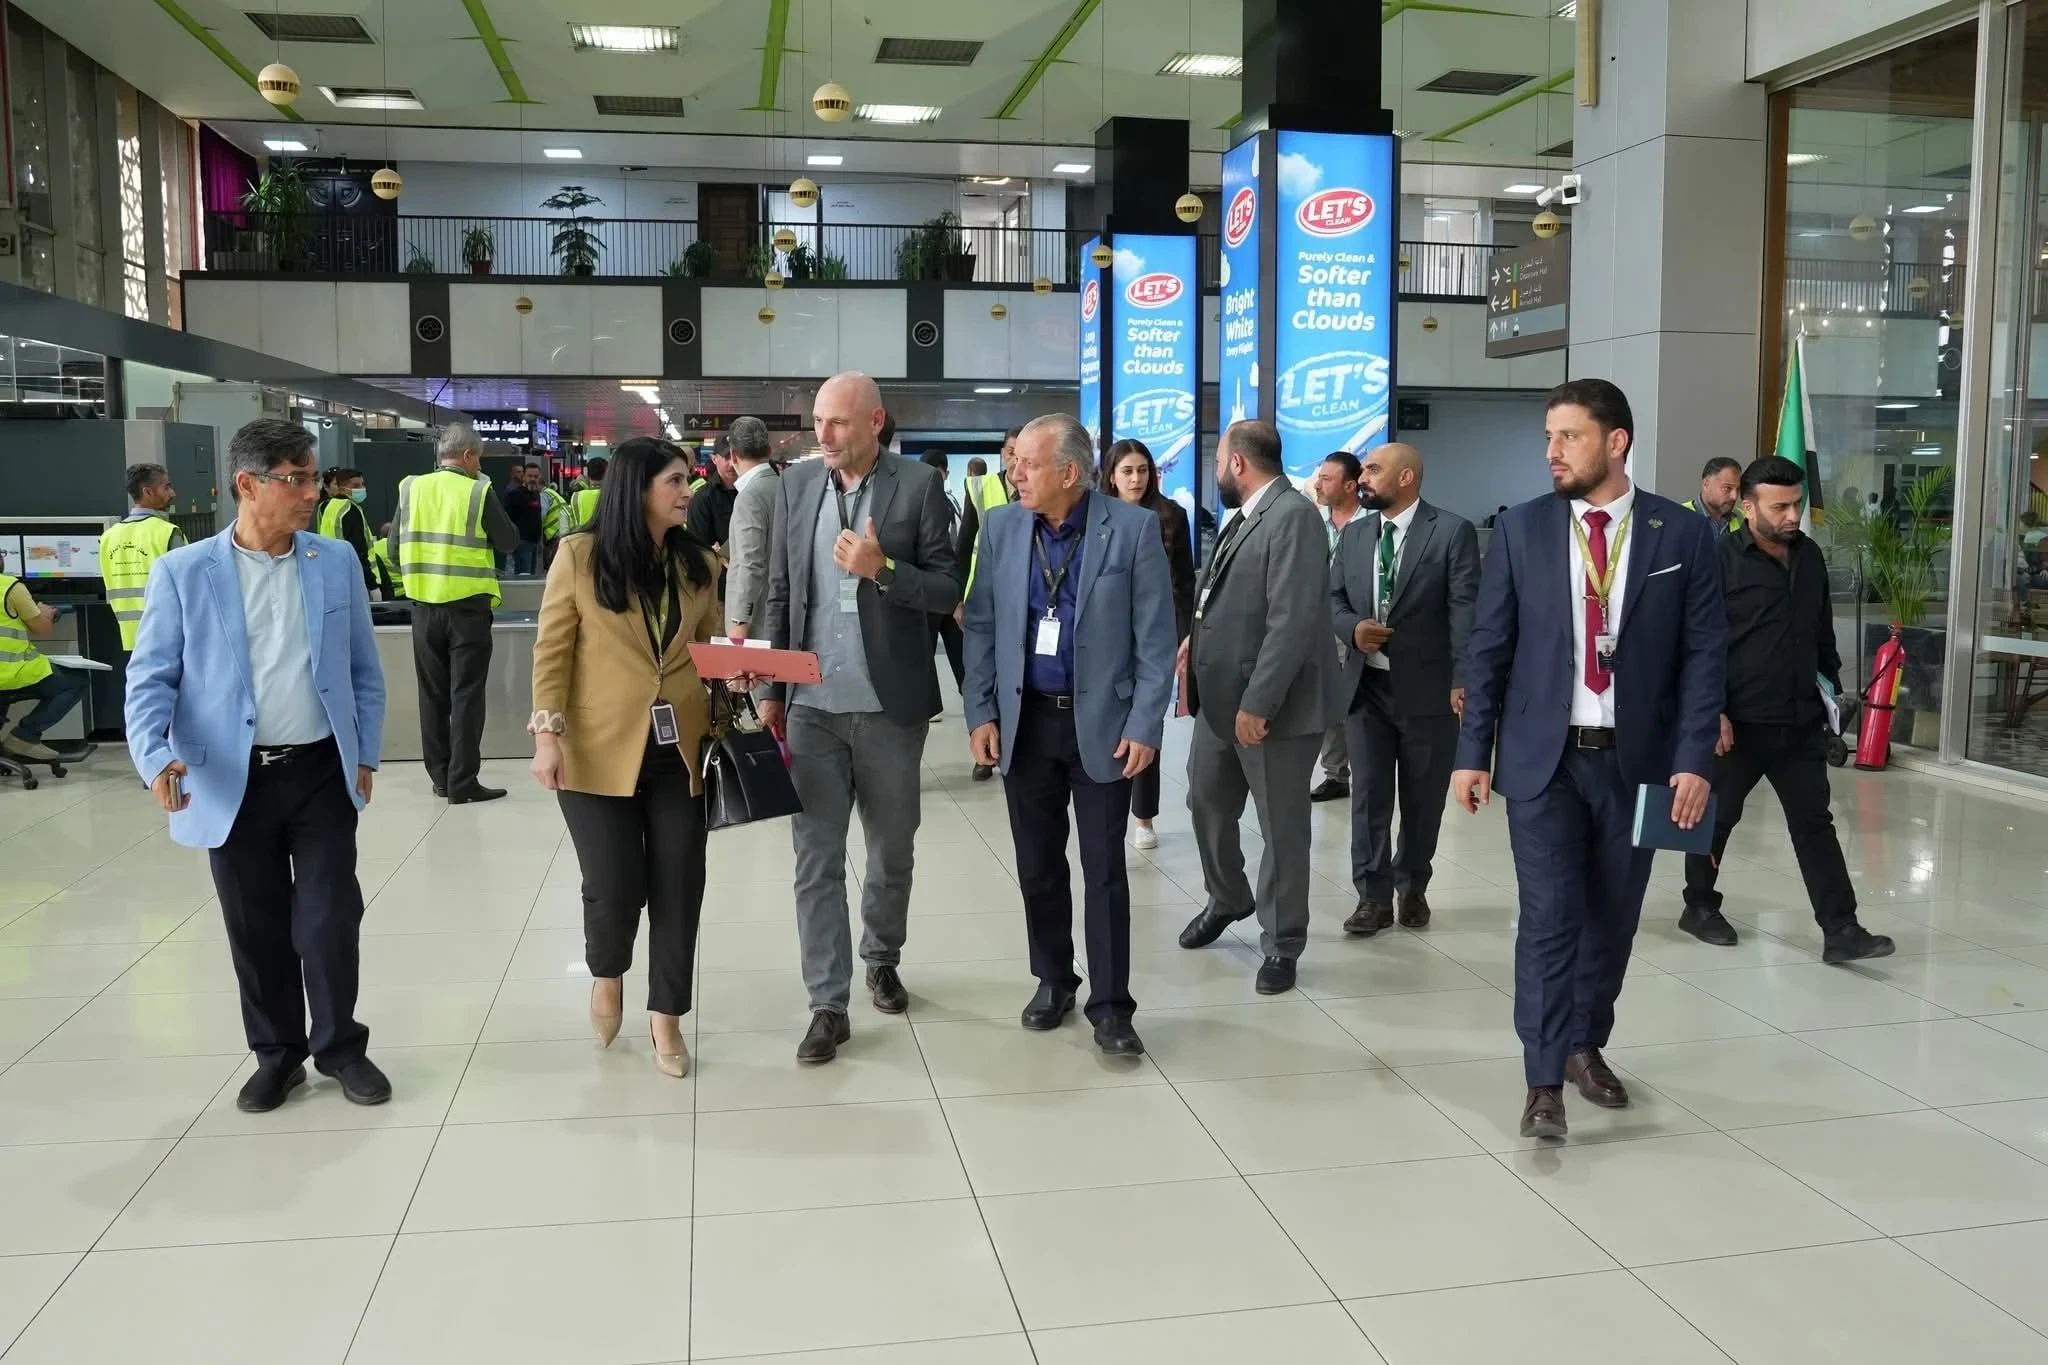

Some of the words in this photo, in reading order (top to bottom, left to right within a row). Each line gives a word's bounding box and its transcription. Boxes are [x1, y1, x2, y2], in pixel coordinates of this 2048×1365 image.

[1229, 193, 1253, 233] LET'S
[1307, 196, 1368, 222] LET'S
[1325, 217, 1352, 226] CLEAN
[1298, 251, 1333, 264] Purely
[1335, 252, 1366, 263] Clean
[1367, 253, 1376, 264] &
[1297, 265, 1372, 286] Softer
[1134, 278, 1178, 298] LET'S
[1306, 287, 1361, 308] than
[1225, 288, 1255, 316] Bright
[1127, 317, 1154, 327] Purely
[1154, 318, 1177, 327] Clean
[1226, 316, 1255, 342] White
[1292, 309, 1376, 331] Clouds
[1127, 327, 1182, 343] Softer
[1133, 344, 1174, 359] than
[1123, 359, 1185, 376] Clouds
[1280, 358, 1390, 408] LET'S
[1116, 394, 1195, 430] LET'S
[1311, 399, 1360, 417] CLEAN
[501, 419, 529, 433] شركة
[1138, 422, 1174, 436] CLEAN
